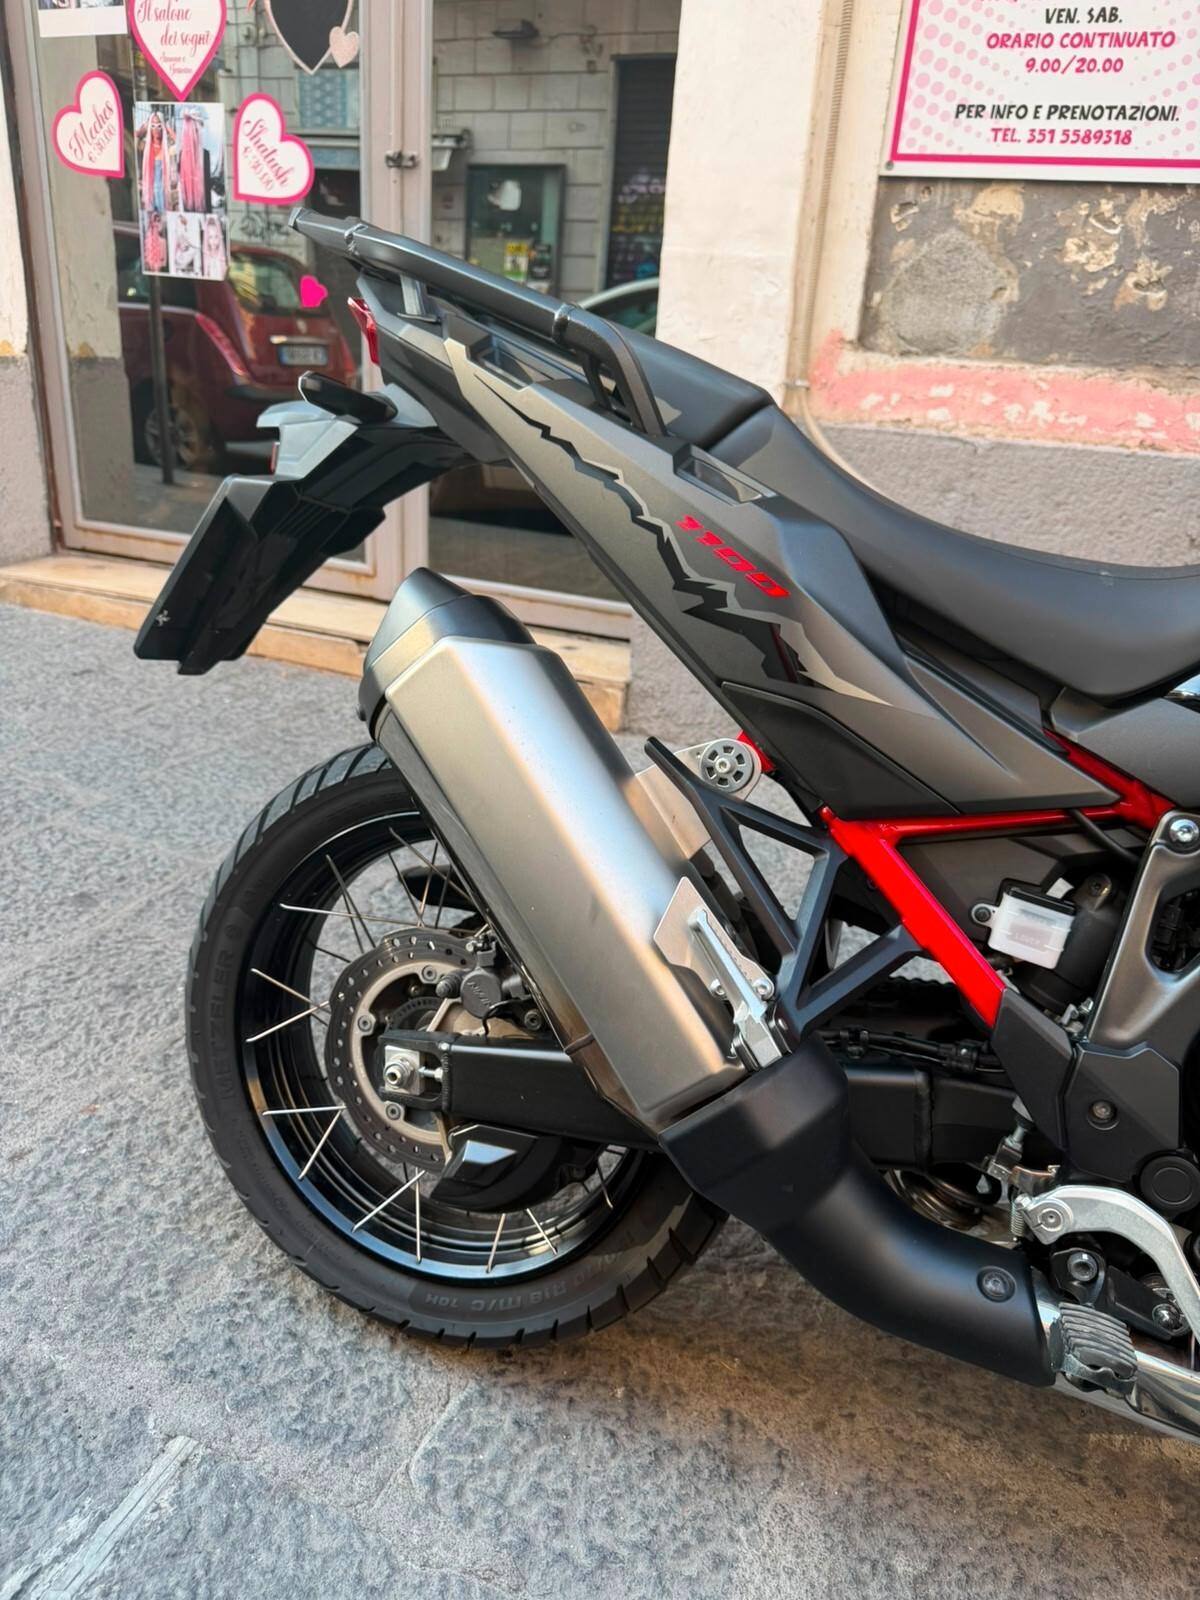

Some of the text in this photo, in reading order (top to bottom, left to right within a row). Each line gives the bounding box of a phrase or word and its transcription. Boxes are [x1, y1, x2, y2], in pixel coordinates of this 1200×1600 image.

[153, 0, 192, 21] salone
[1045, 7, 1123, 24] VEN. SAB.
[180, 30, 212, 57] sogni
[986, 31, 1176, 49] ORARIO CONTINUATO
[1025, 55, 1124, 75] 9.00/20.00
[955, 104, 1180, 122] PER INFO E PRENOTAZIONI.
[991, 128, 1133, 145] TEL. 351 5589318
[242, 118, 294, 188] Shatush
[675, 514, 791, 598] 1100
[210, 950, 235, 1099] METZELER
